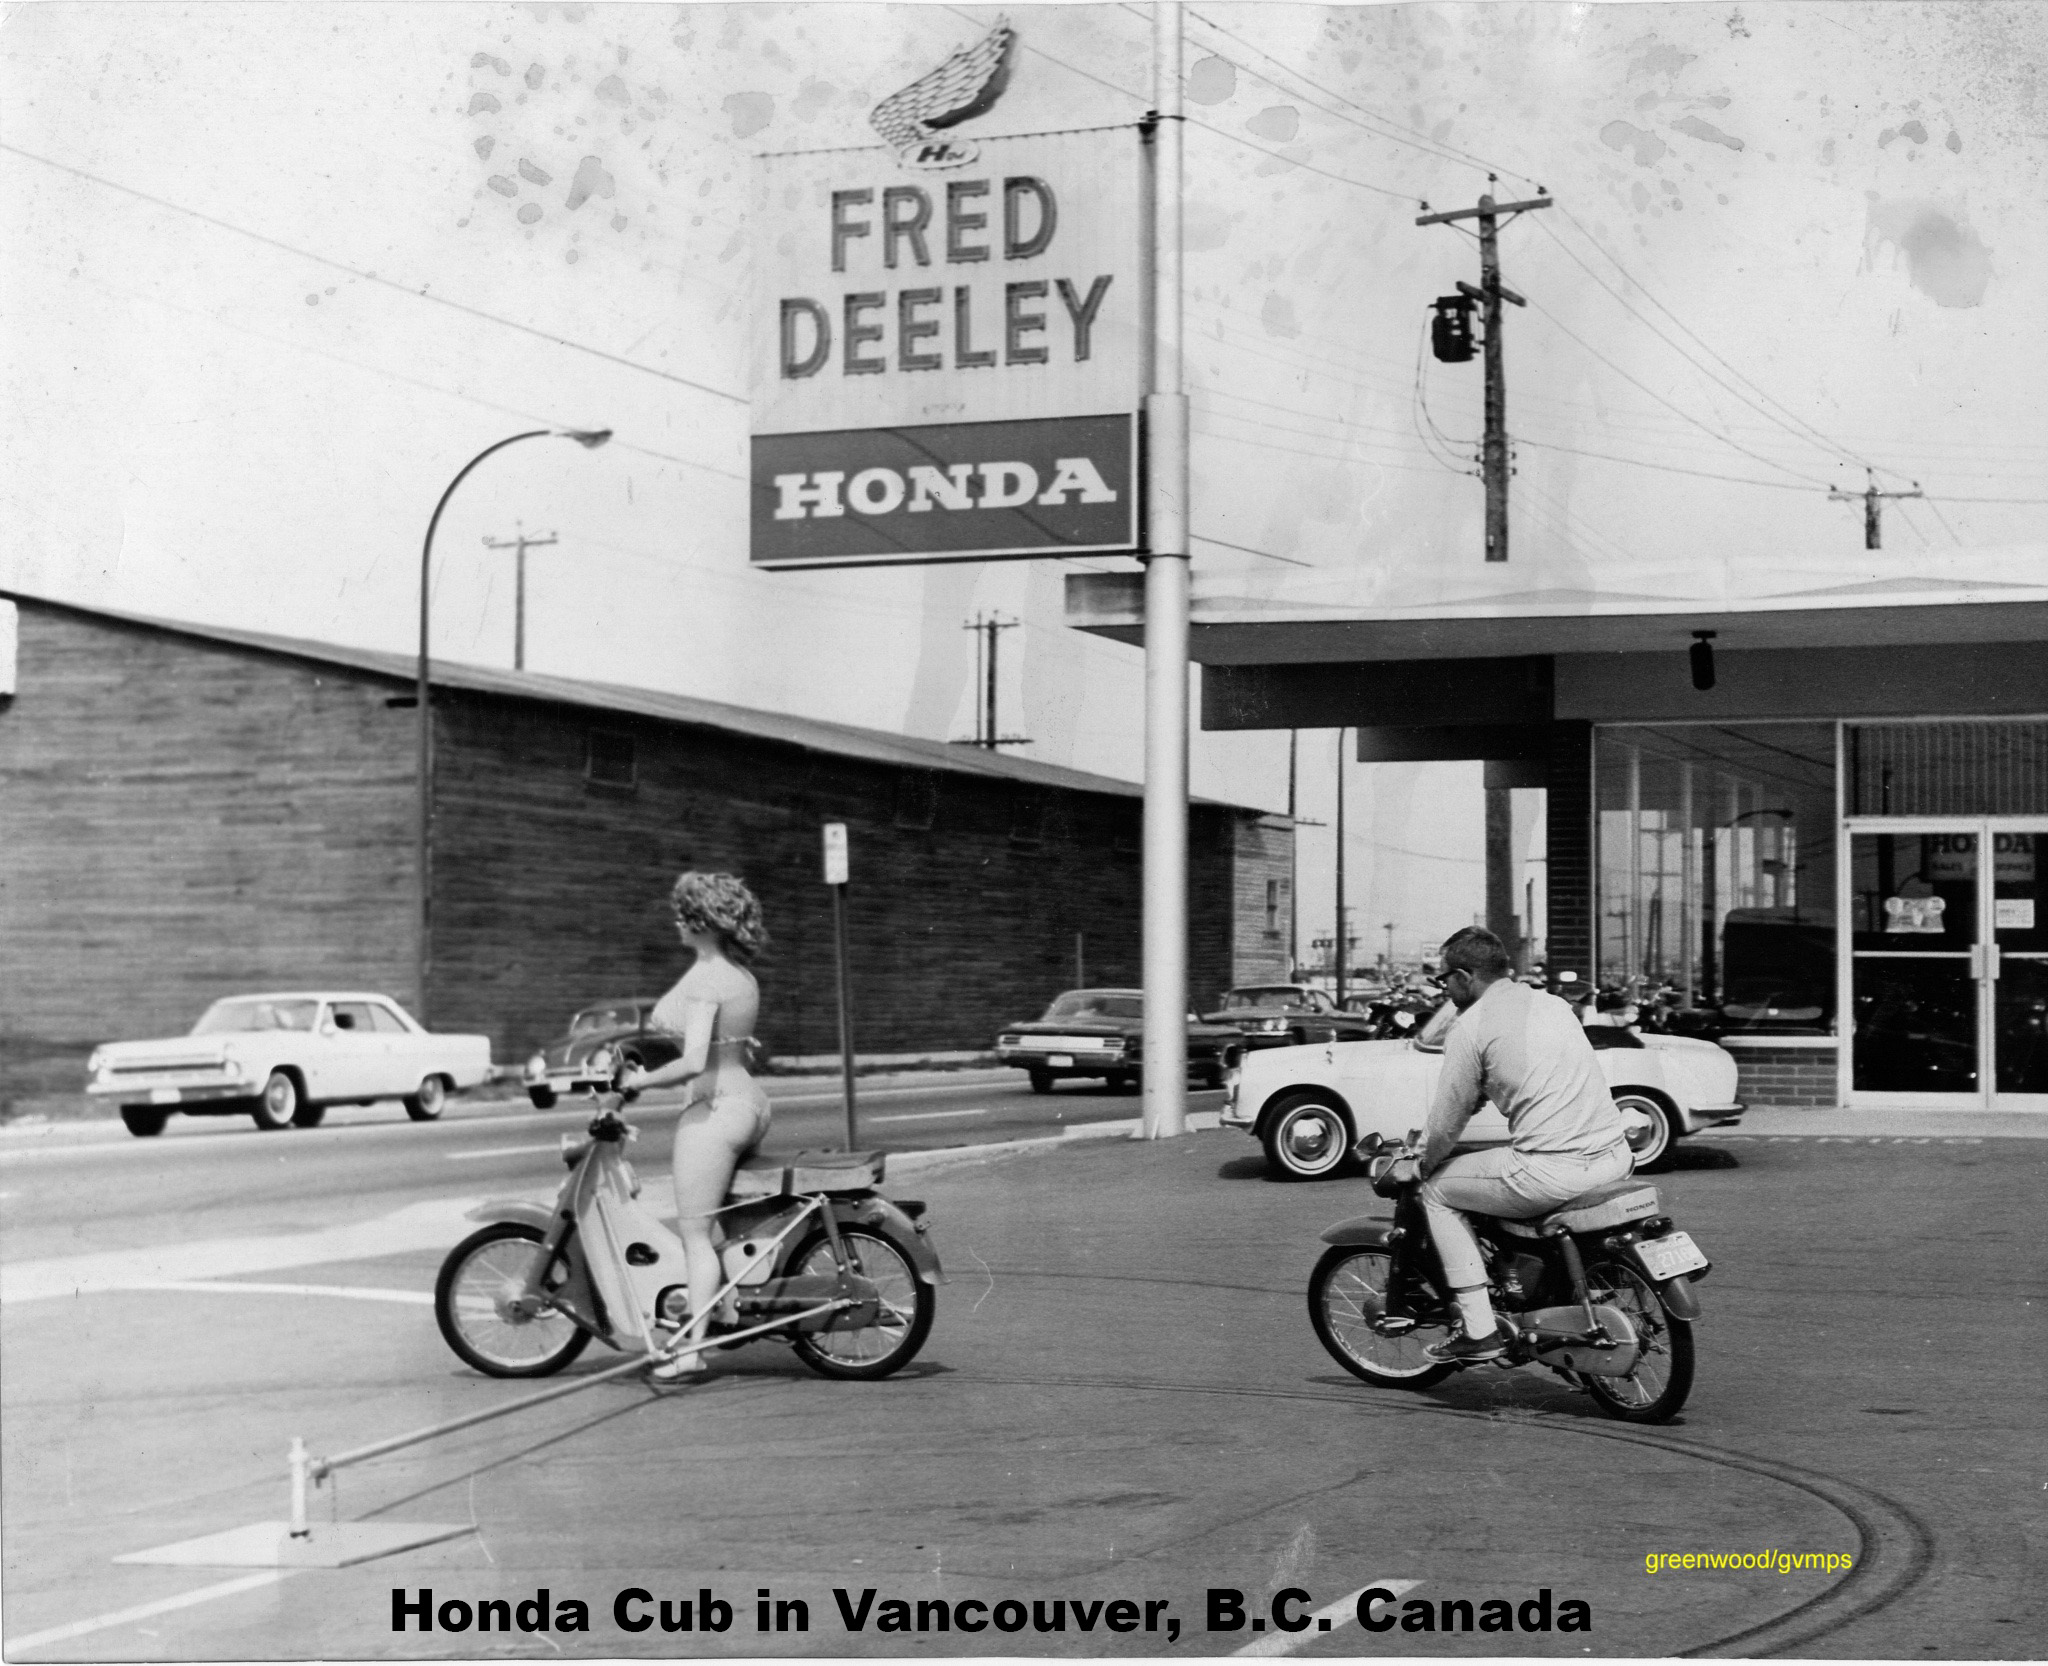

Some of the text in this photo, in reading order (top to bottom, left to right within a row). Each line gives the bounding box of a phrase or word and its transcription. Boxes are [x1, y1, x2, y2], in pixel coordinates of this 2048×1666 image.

[832, 176, 1057, 272] FRED
[779, 275, 1114, 379] DEELEY
[774, 457, 1117, 520] HONDA
[1928, 834, 2031, 853] HODA
[1625, 1200, 1656, 1213] HONDA
